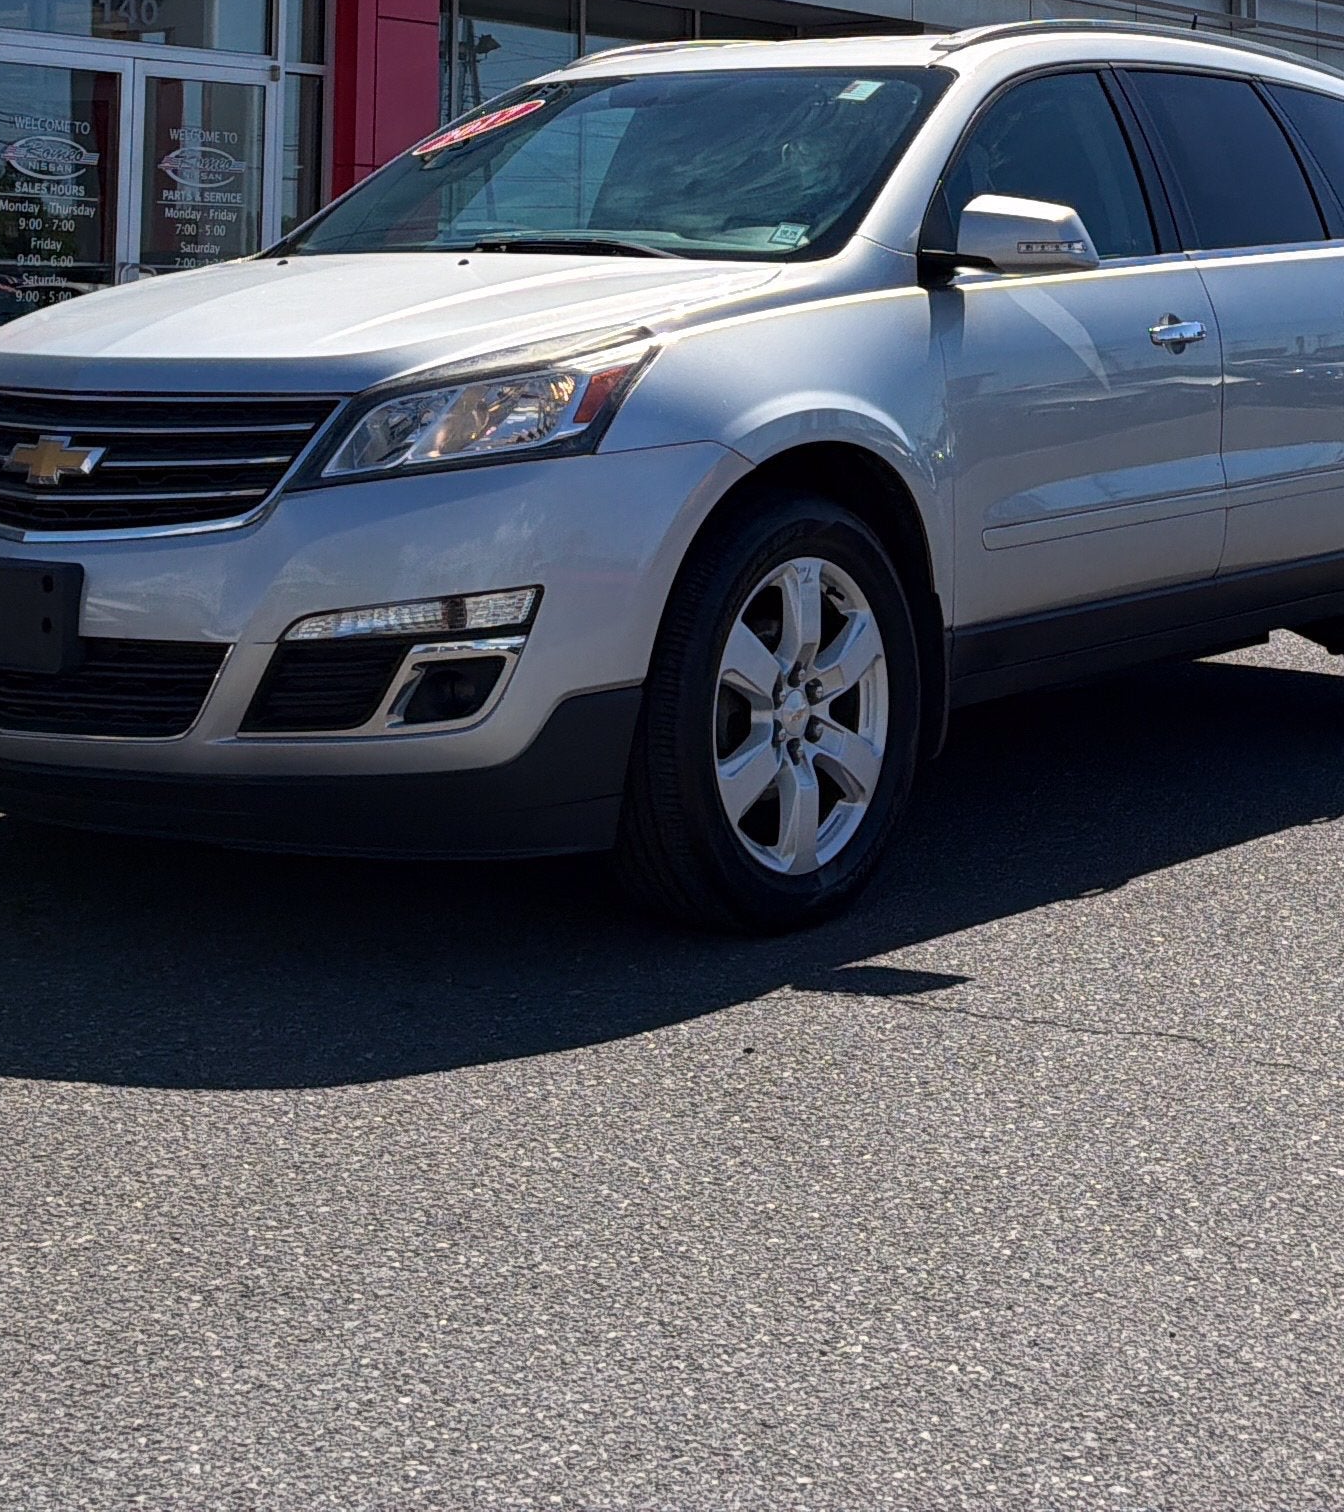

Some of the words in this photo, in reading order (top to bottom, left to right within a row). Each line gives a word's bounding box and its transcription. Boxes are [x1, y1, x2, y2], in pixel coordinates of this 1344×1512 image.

[14, 116, 71, 133] WELCOME
[73, 122, 90, 134] TO
[169, 128, 220, 144] WELCOME
[222, 132, 238, 144] TO
[28, 161, 72, 173] NISSAN
[15, 182, 47, 194] SALES
[50, 184, 85, 197] HOURS
[162, 190, 192, 201] PARTS
[195, 191, 201, 201] &
[204, 192, 243, 203] SERVICE
[0, 199, 40, 215] Monday
[50, 202, 96, 218] Thursday
[165, 207, 201, 221] Monday
[209, 209, 237, 222] Friday
[19, 218, 42, 230] 9:00
[52, 220, 75, 231] 7:00
[176, 224, 196, 235] 7:00
[205, 225, 226, 236] 5:00
[31, 237, 62, 252] Friday
[180, 242, 220, 254] Saturday
[17, 254, 41, 266] 9:00
[51, 255, 74, 267] 6:00
[175, 258, 196, 268] 7:00
[22, 273, 67, 288] Saturday
[16, 290, 40, 302] 9:00
[49, 291, 72, 302] 5:00
